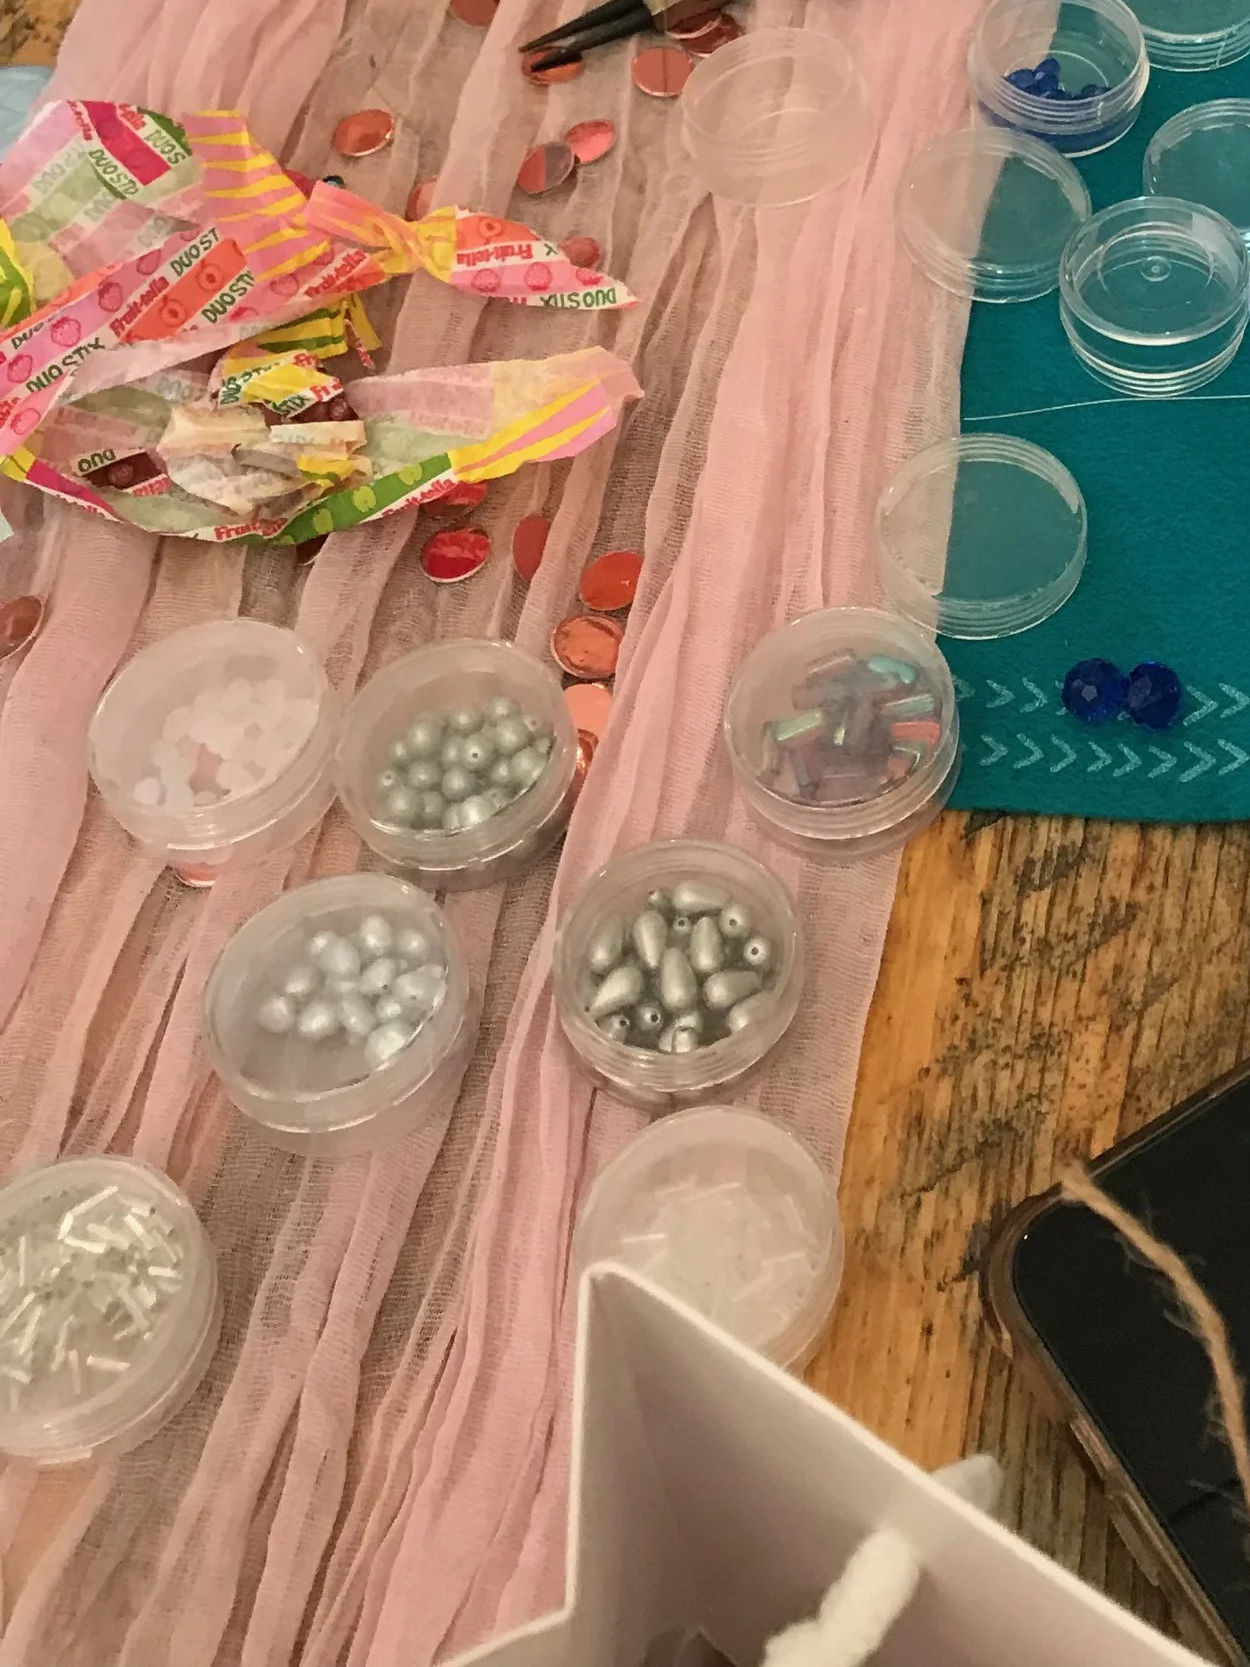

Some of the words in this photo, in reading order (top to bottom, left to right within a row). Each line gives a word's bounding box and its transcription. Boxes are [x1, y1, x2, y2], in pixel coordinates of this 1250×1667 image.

[170, 246, 201, 277] DUO
[201, 291, 236, 324] DUO
[582, 287, 617, 308] DUO
